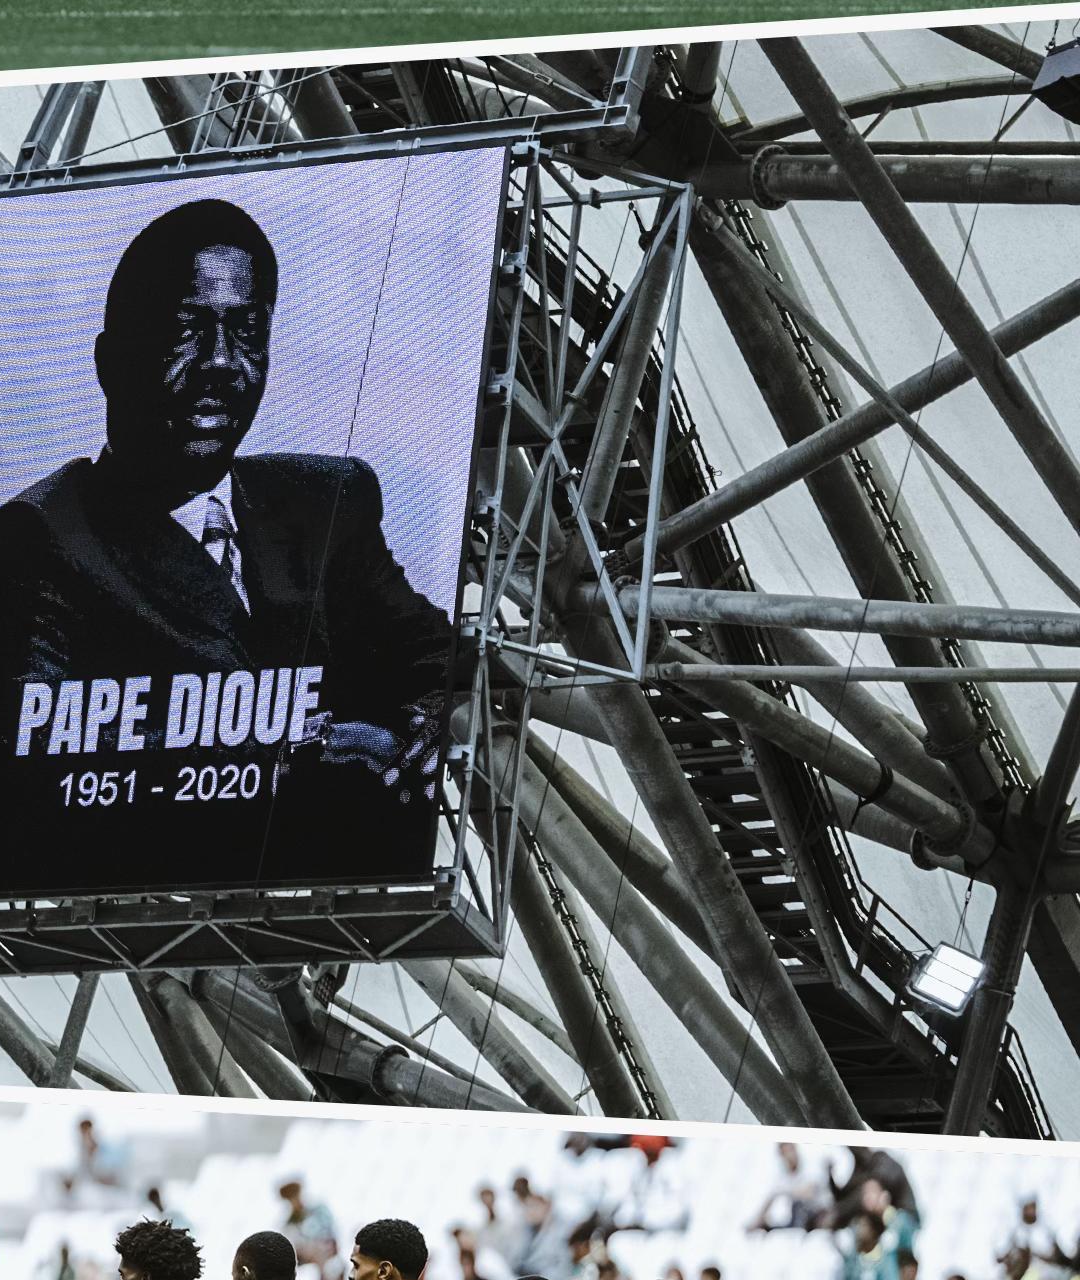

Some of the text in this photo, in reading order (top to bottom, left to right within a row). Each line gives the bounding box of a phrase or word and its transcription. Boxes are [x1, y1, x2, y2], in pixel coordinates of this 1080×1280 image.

[15, 665, 323, 756] PAPE DIOUF
[59, 769, 137, 807] 1951
[174, 763, 261, 802] 2020
